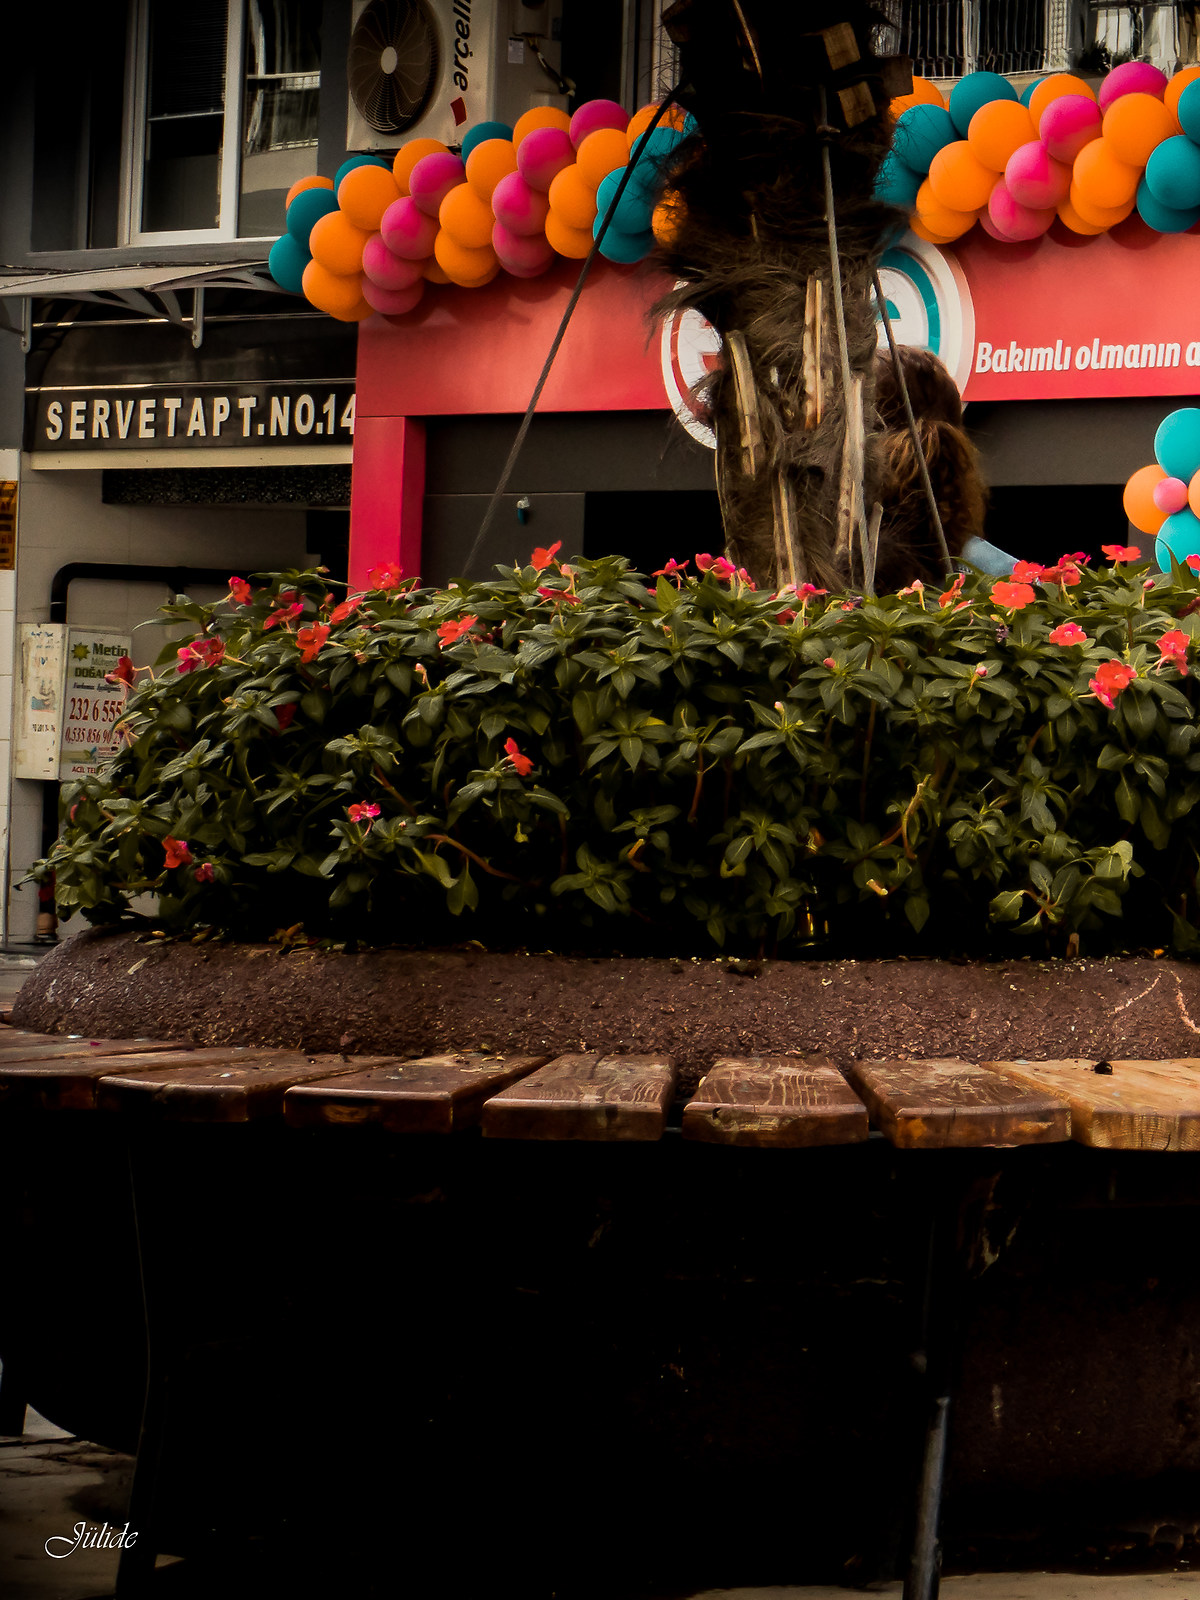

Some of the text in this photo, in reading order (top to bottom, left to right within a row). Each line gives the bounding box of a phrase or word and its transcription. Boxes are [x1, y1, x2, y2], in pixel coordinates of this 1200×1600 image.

[452, 0, 473, 92] arçeli
[975, 339, 1072, 373] Bakımlı
[1075, 338, 1182, 370] olmanın
[92, 642, 129, 657] Metin
[69, 697, 123, 723] 232 6 555
